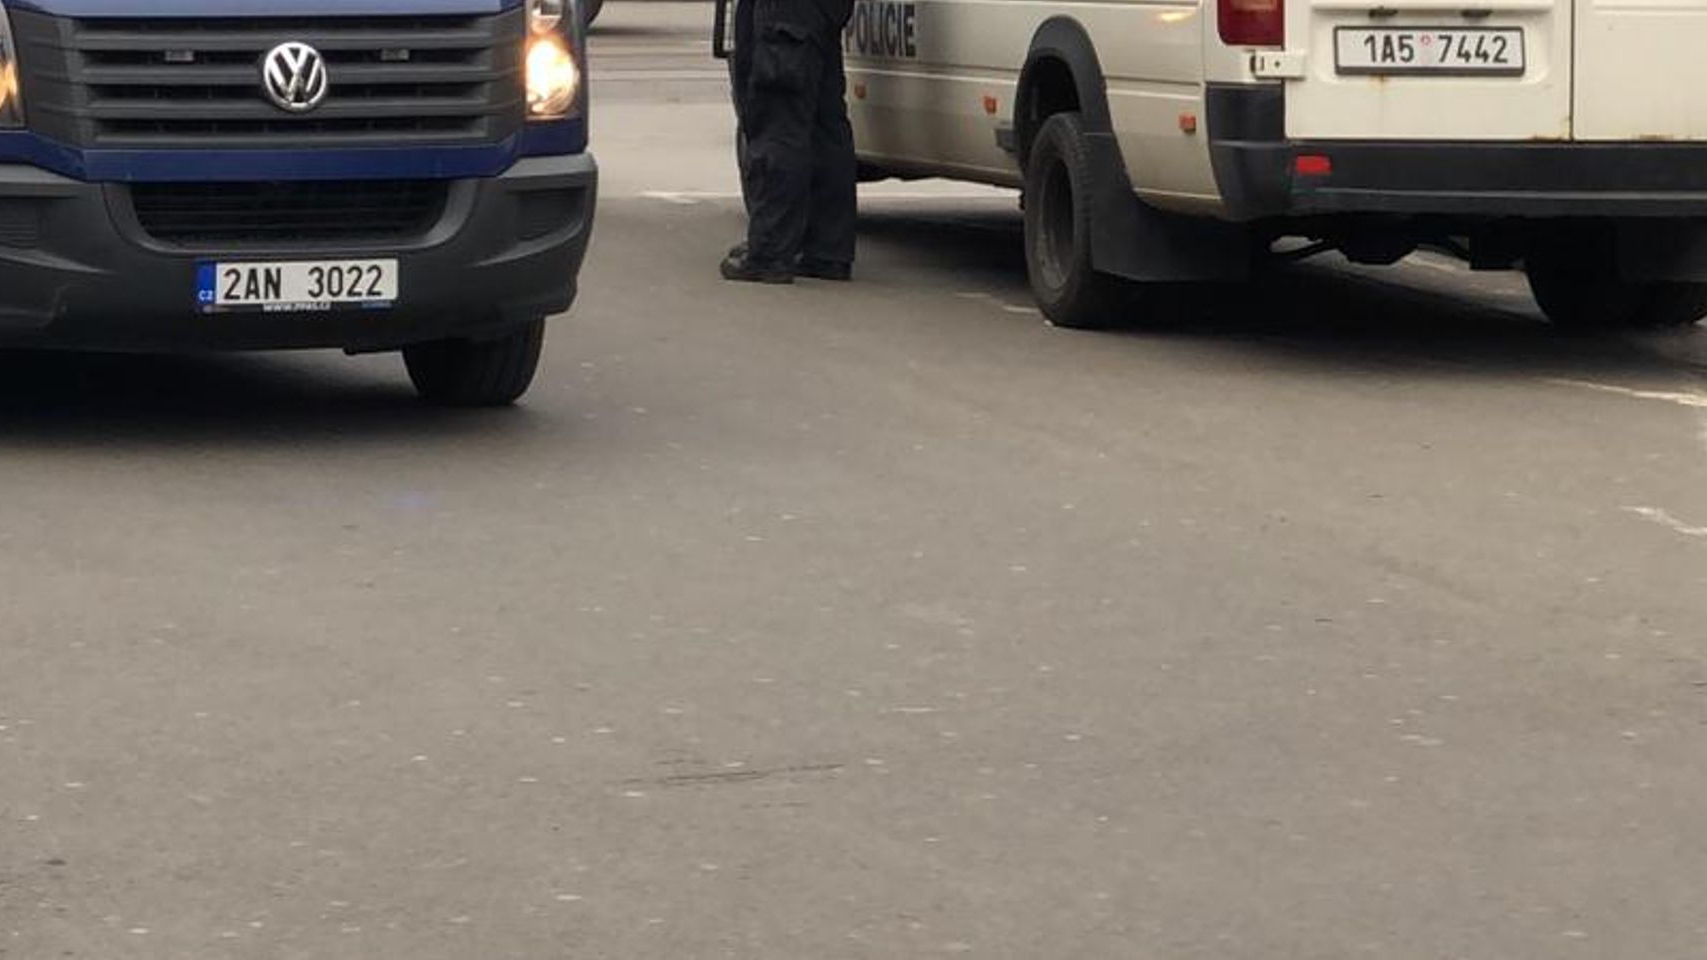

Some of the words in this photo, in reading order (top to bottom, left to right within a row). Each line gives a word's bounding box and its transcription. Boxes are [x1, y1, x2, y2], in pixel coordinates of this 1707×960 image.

[1363, 34, 1415, 64] 1A5
[1437, 34, 1509, 64] 7442
[223, 267, 282, 300] 2AN
[307, 264, 383, 298] 3022
